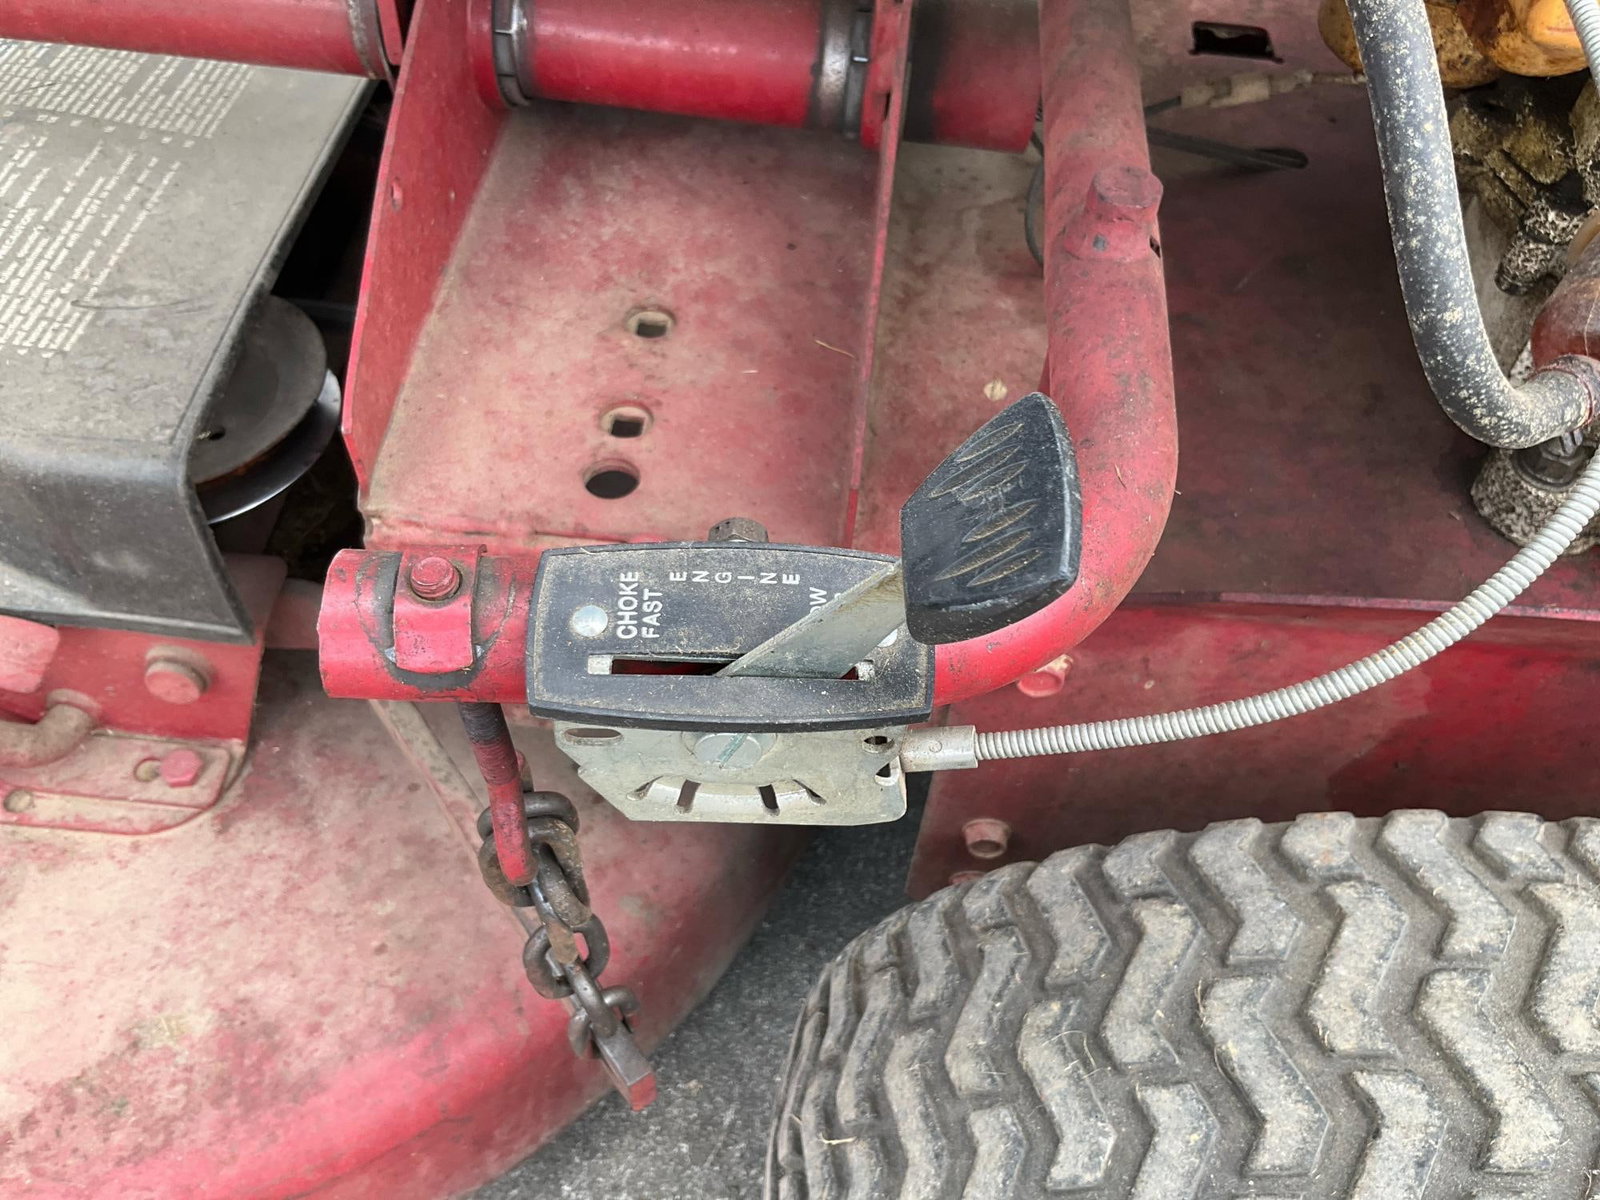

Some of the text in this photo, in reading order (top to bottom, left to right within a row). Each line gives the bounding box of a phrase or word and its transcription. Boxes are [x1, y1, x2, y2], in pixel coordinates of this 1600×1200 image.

[669, 570, 801, 585] ENGINE
[616, 571, 640, 639] CHOKE
[641, 588, 663, 638] FAST
